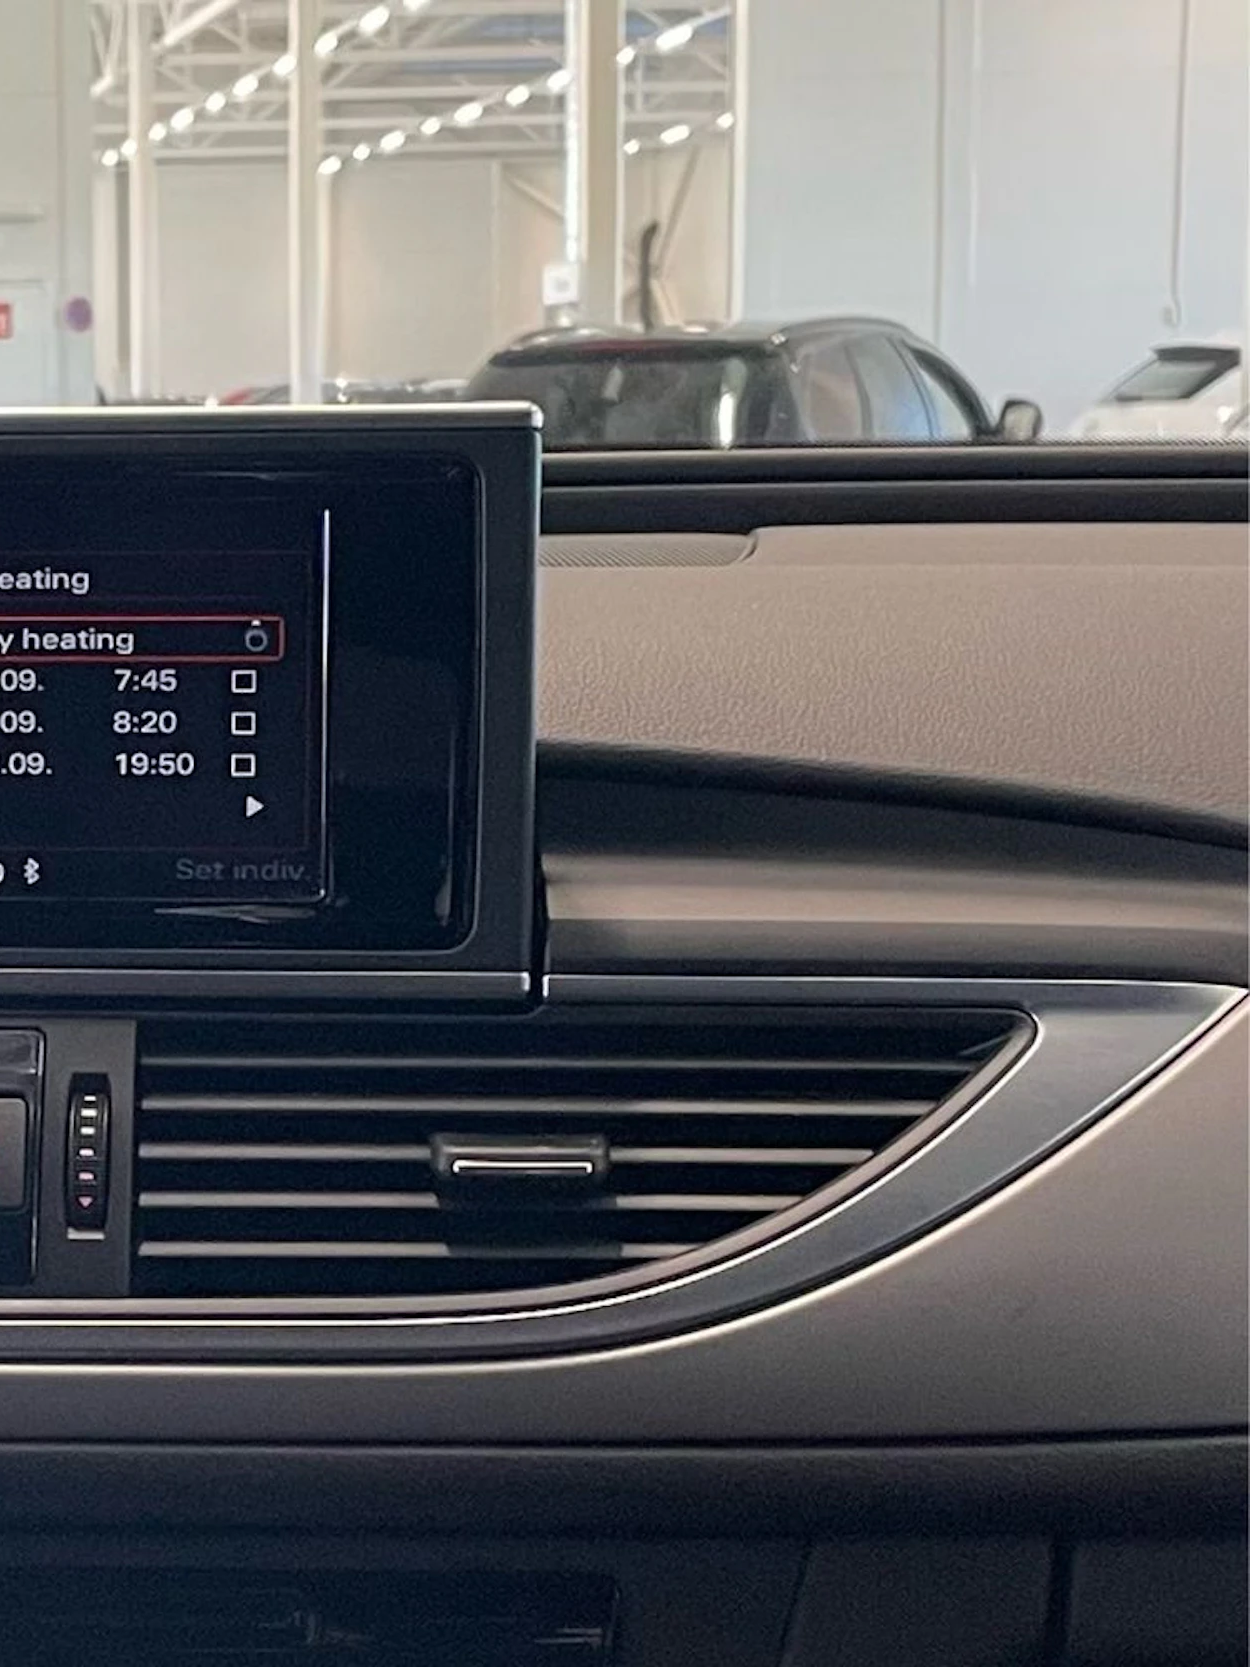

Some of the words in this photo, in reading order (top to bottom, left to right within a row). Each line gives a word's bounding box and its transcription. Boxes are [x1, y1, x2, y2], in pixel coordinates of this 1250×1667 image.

[21, 626, 136, 656] heating
[114, 668, 179, 692] 7:45
[112, 709, 178, 734] 8:20
[115, 751, 196, 775] 19:50
[175, 857, 225, 880] Set
